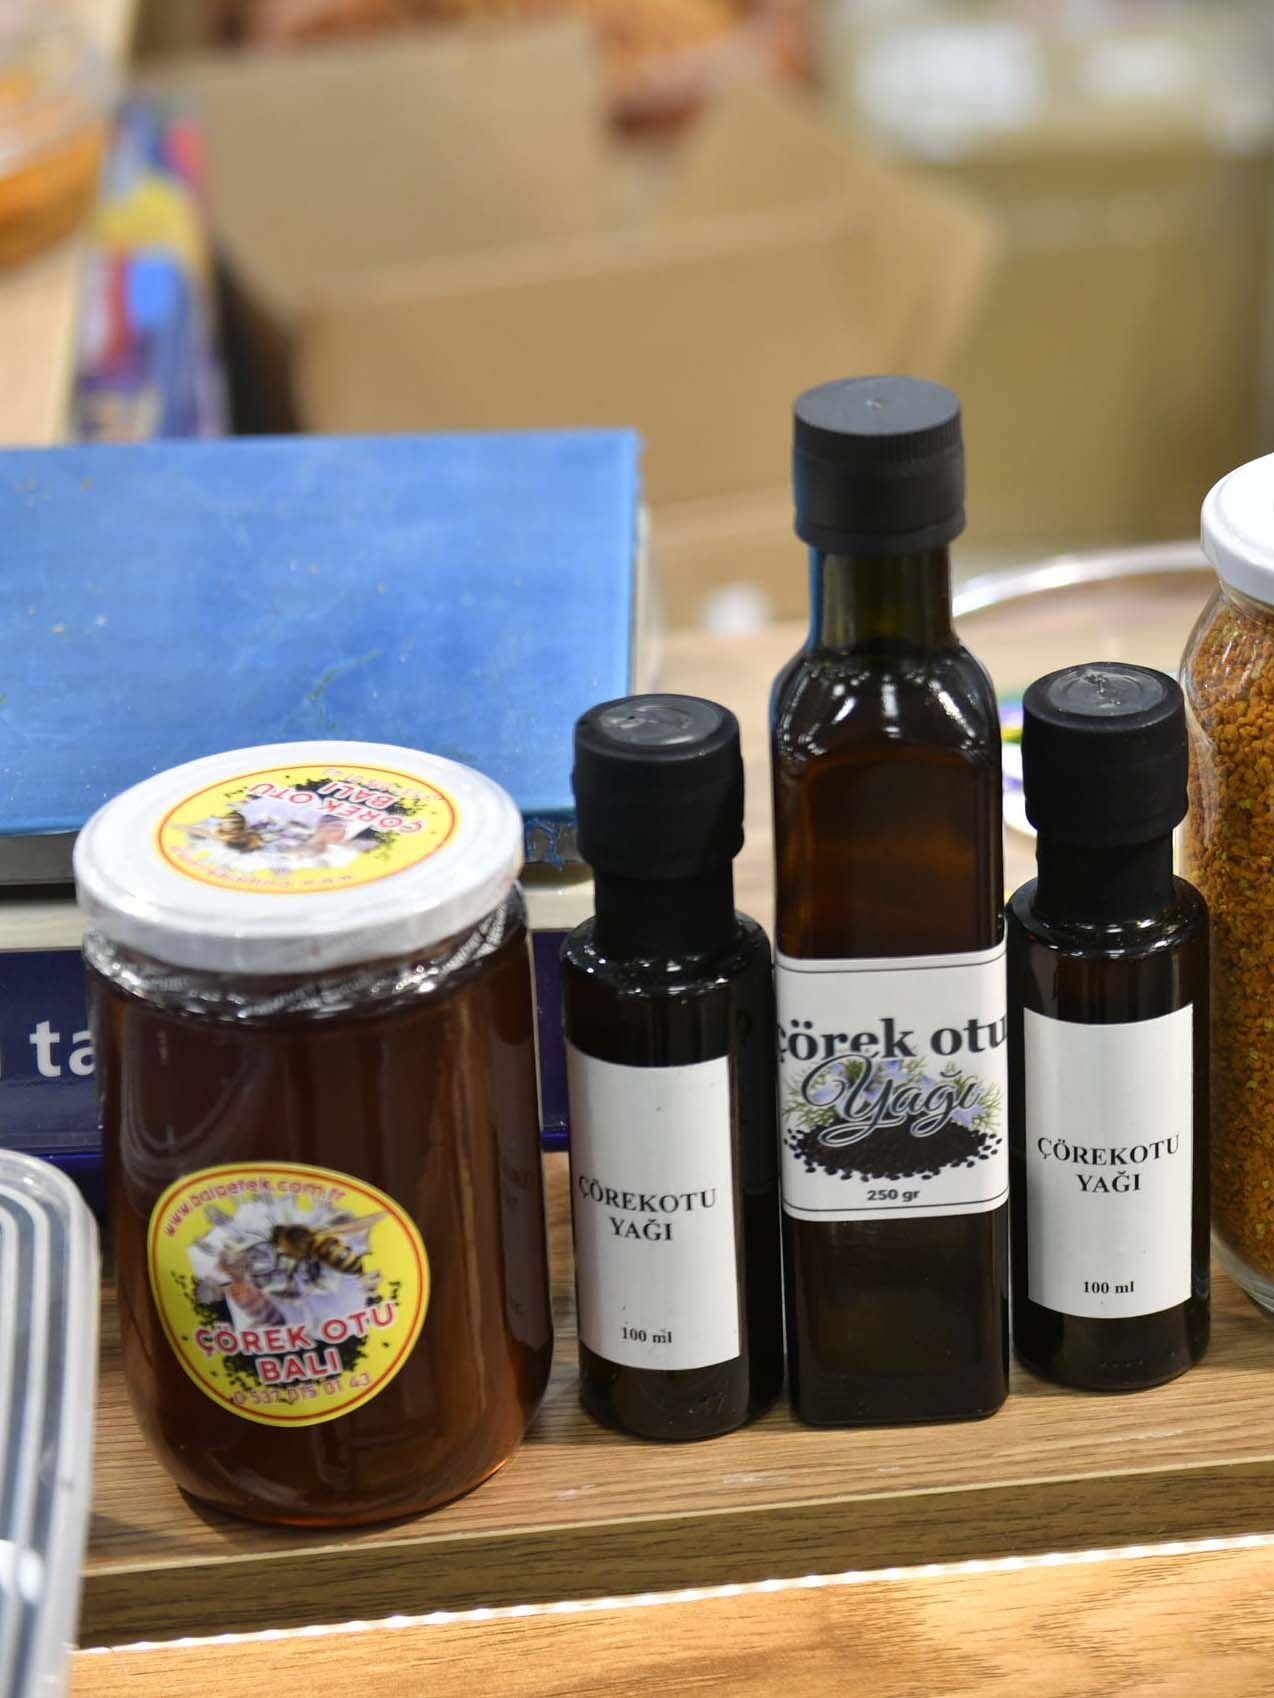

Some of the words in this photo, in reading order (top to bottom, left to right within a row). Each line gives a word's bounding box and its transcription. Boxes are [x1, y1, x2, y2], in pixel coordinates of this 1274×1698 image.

[249, 783, 314, 805] OTU
[319, 781, 391, 810] BALI
[1037, 1134, 1181, 1166] ÇÖREKOTU
[578, 1175, 717, 1214] ÇÖREKOTU
[1076, 1171, 1142, 1193] YAĞI
[164, 1177, 347, 1238] www.balpetek.com.tr
[867, 1189, 899, 1202] 250
[902, 1189, 920, 1203] gr
[609, 1216, 673, 1242] YAĞI
[1084, 1281, 1110, 1294] 100
[1115, 1281, 1134, 1294] ml
[195, 1320, 312, 1358] ÇÖREK
[322, 1302, 395, 1342] OTU
[622, 1326, 647, 1342] 100
[652, 1330, 672, 1344] ml
[259, 1349, 342, 1385] BALI
